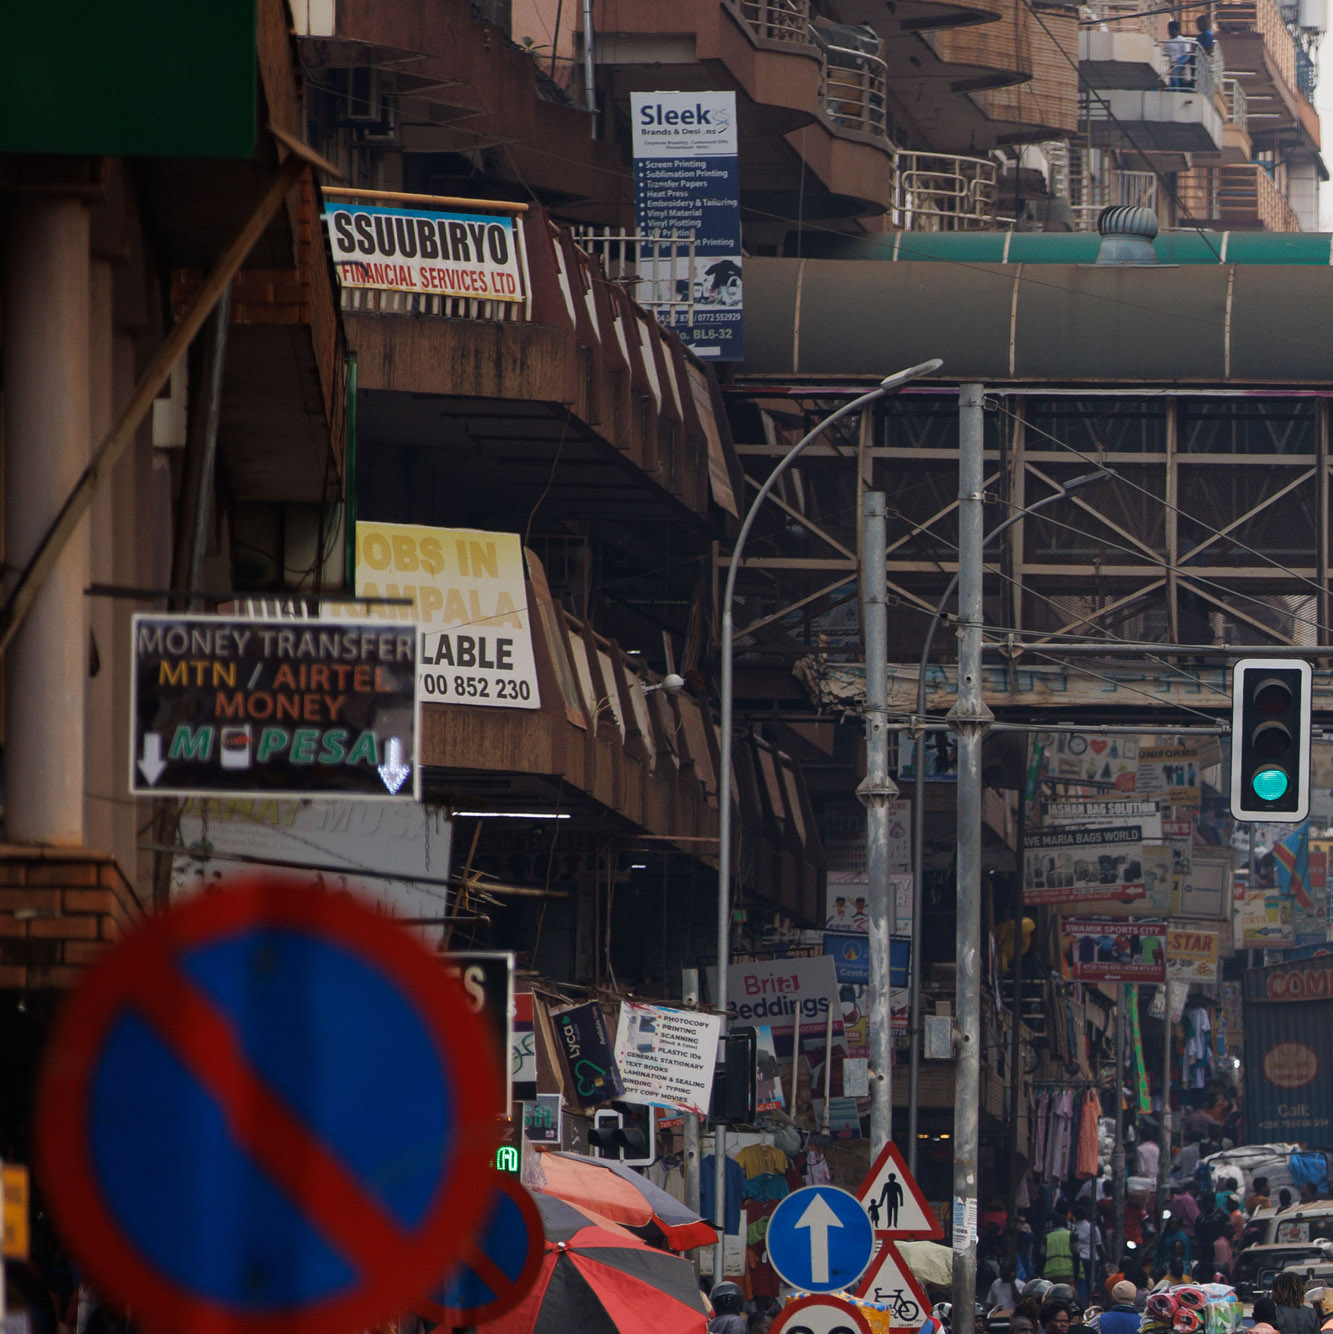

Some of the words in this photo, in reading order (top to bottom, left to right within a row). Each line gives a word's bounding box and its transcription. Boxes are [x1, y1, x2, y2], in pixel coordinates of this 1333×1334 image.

[640, 103, 711, 126] Sleek
[645, 161, 673, 169] Screen
[674, 160, 707, 169] Printing
[646, 170, 696, 178] Sublimation
[696, 169, 729, 178] Printing
[647, 180, 680, 188] Transfer
[680, 180, 708, 189] Papers
[647, 190, 666, 198] Heat
[667, 190, 688, 198] Press
[647, 199, 694, 208] Embroidery
[703, 198, 738, 208] Tailoring
[647, 209, 668, 218] Vinyl
[668, 209, 702, 217] Material
[647, 219, 668, 228] Vinyl
[669, 219, 702, 228] Plotting
[334, 211, 509, 265] SSUUBIRYO
[701, 239, 735, 248] Printing
[341, 260, 417, 287] FINANCIAL
[419, 267, 488, 293] SERVICES
[490, 271, 516, 295] LTD
[693, 328, 733, 340] BL6-32
[455, 539, 500, 579] IN
[138, 628, 251, 656] MONEY
[257, 630, 414, 662] TRANSFER
[158, 659, 237, 687] MTN
[272, 663, 392, 692] AIRTEL
[454, 675, 490, 698] 852
[495, 678, 531, 701] 230
[214, 690, 346, 721] MONEY
[168, 724, 214, 761] M
[256, 727, 379, 765] PESA
[1138, 750, 1198, 759] UNIFORMS
[1108, 801, 1156, 813] SOLUTION
[1042, 833, 1074, 845] MARIA
[1075, 831, 1103, 844] BAGS
[1104, 829, 1139, 841] WORLD
[1104, 925, 1139, 935] SPORTS
[1139, 926, 1160, 935] CITY
[663, 1015, 710, 1029] PHOTOCOPY
[661, 1023, 697, 1035] PRINTING
[660, 1032, 699, 1044] SCANNING
[657, 1047, 688, 1058] PLASTIC
[689, 1051, 702, 1060] IDs
[625, 1060, 643, 1068] TEXT
[643, 1064, 668, 1073] BOOKS
[626, 1051, 659, 1062] GENERAL
[660, 1057, 704, 1070] STATIONARY
[623, 1068, 668, 1081] LAMINATION
[674, 1078, 705, 1089] SEALING
[639, 1089, 660, 1098] COPY
[660, 1093, 688, 1103] MOVIES
[665, 1085, 691, 1095] TYPING
